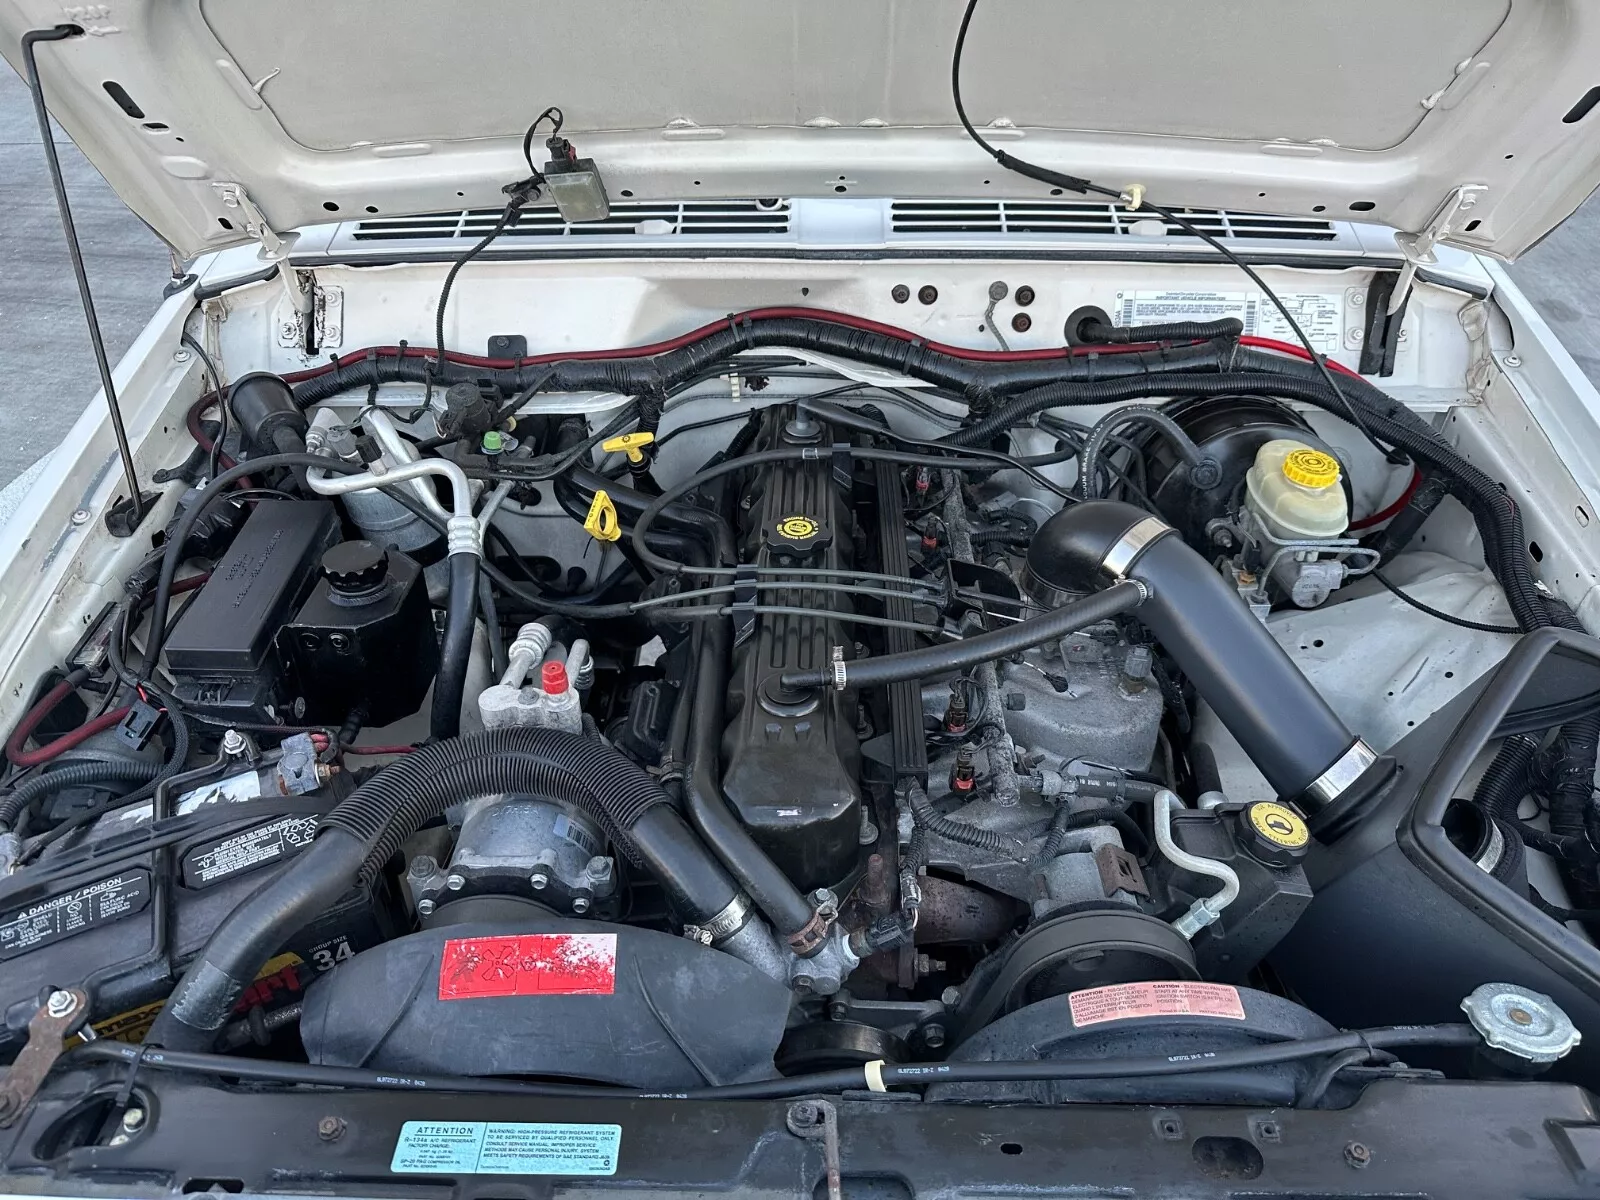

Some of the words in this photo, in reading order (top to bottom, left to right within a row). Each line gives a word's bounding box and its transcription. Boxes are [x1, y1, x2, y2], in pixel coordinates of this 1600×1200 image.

[1268, 804, 1297, 819] APPROVED
[1268, 834, 1300, 845] STEERING
[29, 895, 72, 915] DANGER
[83, 878, 122, 896] POISON
[333, 935, 347, 944] SIZE
[313, 941, 355, 970] 34
[1071, 990, 1103, 999] ATTENTION
